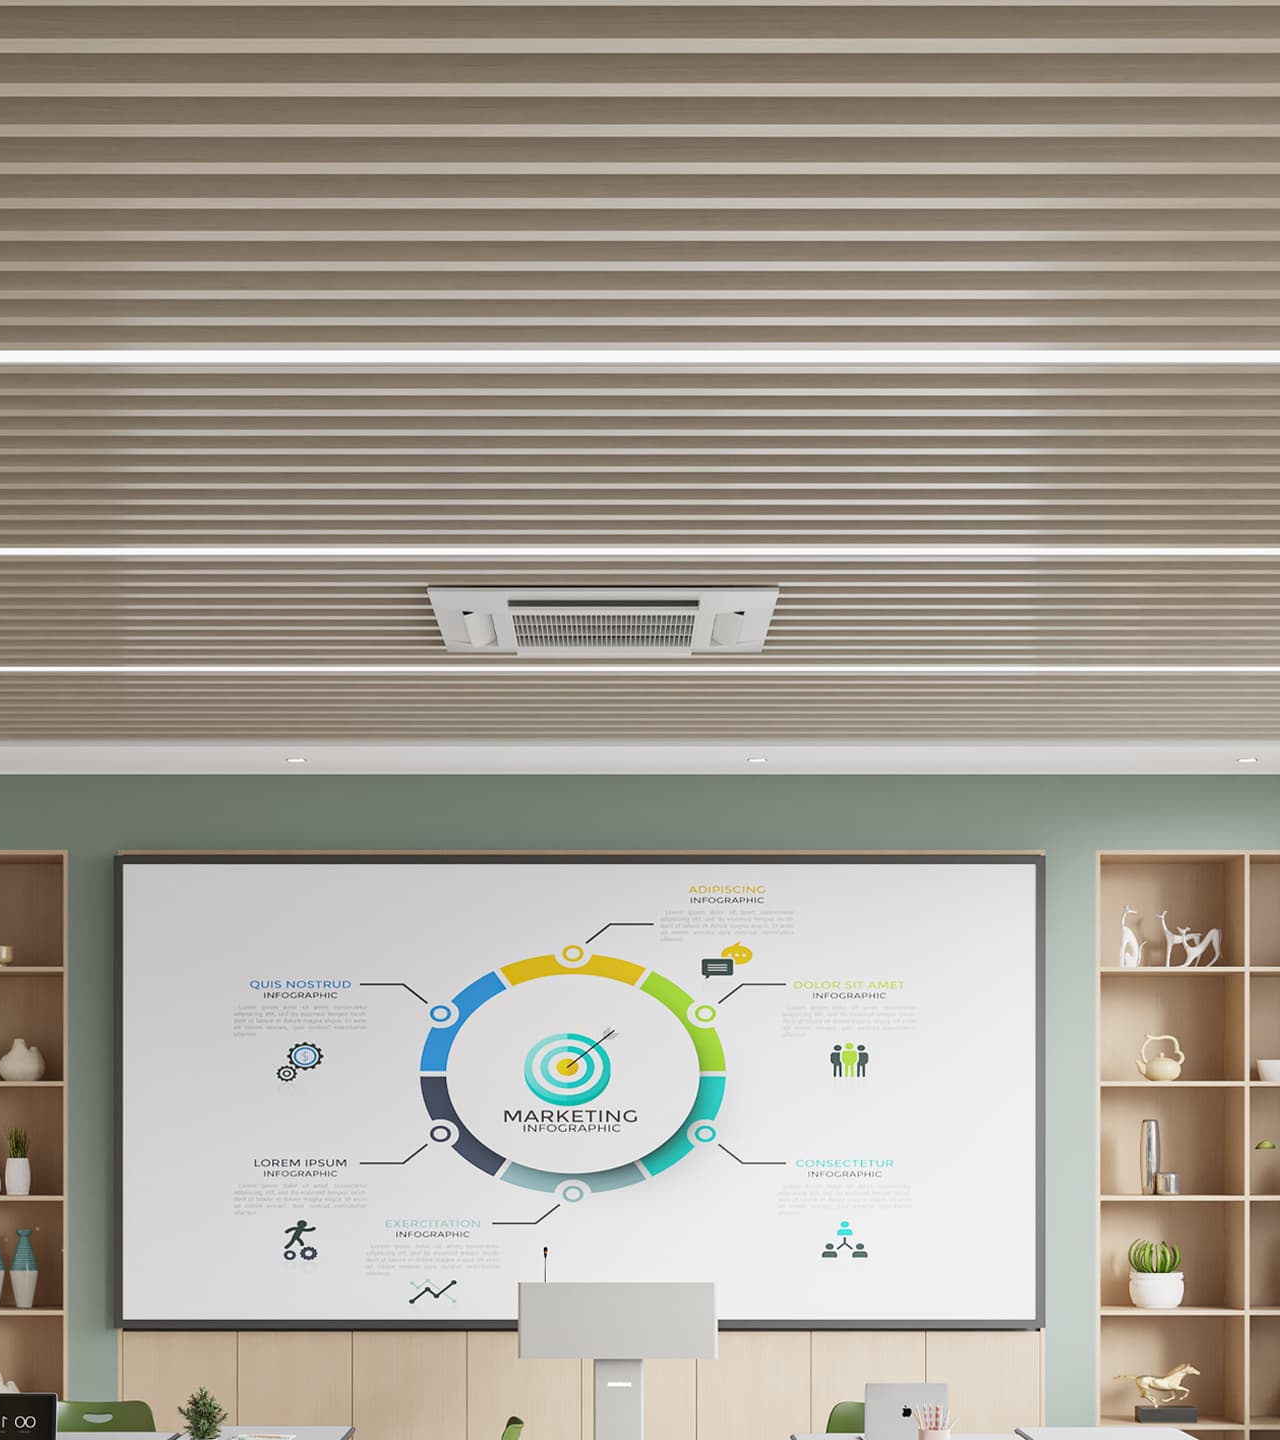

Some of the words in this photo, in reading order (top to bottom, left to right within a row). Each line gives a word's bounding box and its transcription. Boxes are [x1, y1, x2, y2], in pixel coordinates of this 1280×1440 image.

[687, 884, 767, 895] ADIPISCING
[689, 895, 765, 905] INFOGRAPHIC
[248, 979, 282, 991] QUIS
[285, 979, 352, 990] NOSTRUD
[792, 979, 843, 990] DOLOR
[844, 979, 865, 990] SIT
[867, 979, 905, 990] AMET
[262, 991, 338, 1000] INFOGRAPHIC
[811, 991, 887, 1001] INFOGRAPHIC
[503, 1109, 638, 1123] MARKETING
[522, 1123, 622, 1133] INFOGRAPHIC
[253, 1158, 301, 1168] LOREM
[305, 1158, 348, 1168] IPSUM
[795, 1158, 895, 1169] CONSECTETUR
[262, 1169, 338, 1178] INFOGRAPHIC
[807, 1169, 883, 1179] INFOGRAPHIC
[383, 1218, 482, 1230] EXERCITATION
[395, 1230, 471, 1239] INFOGRAPHIC
